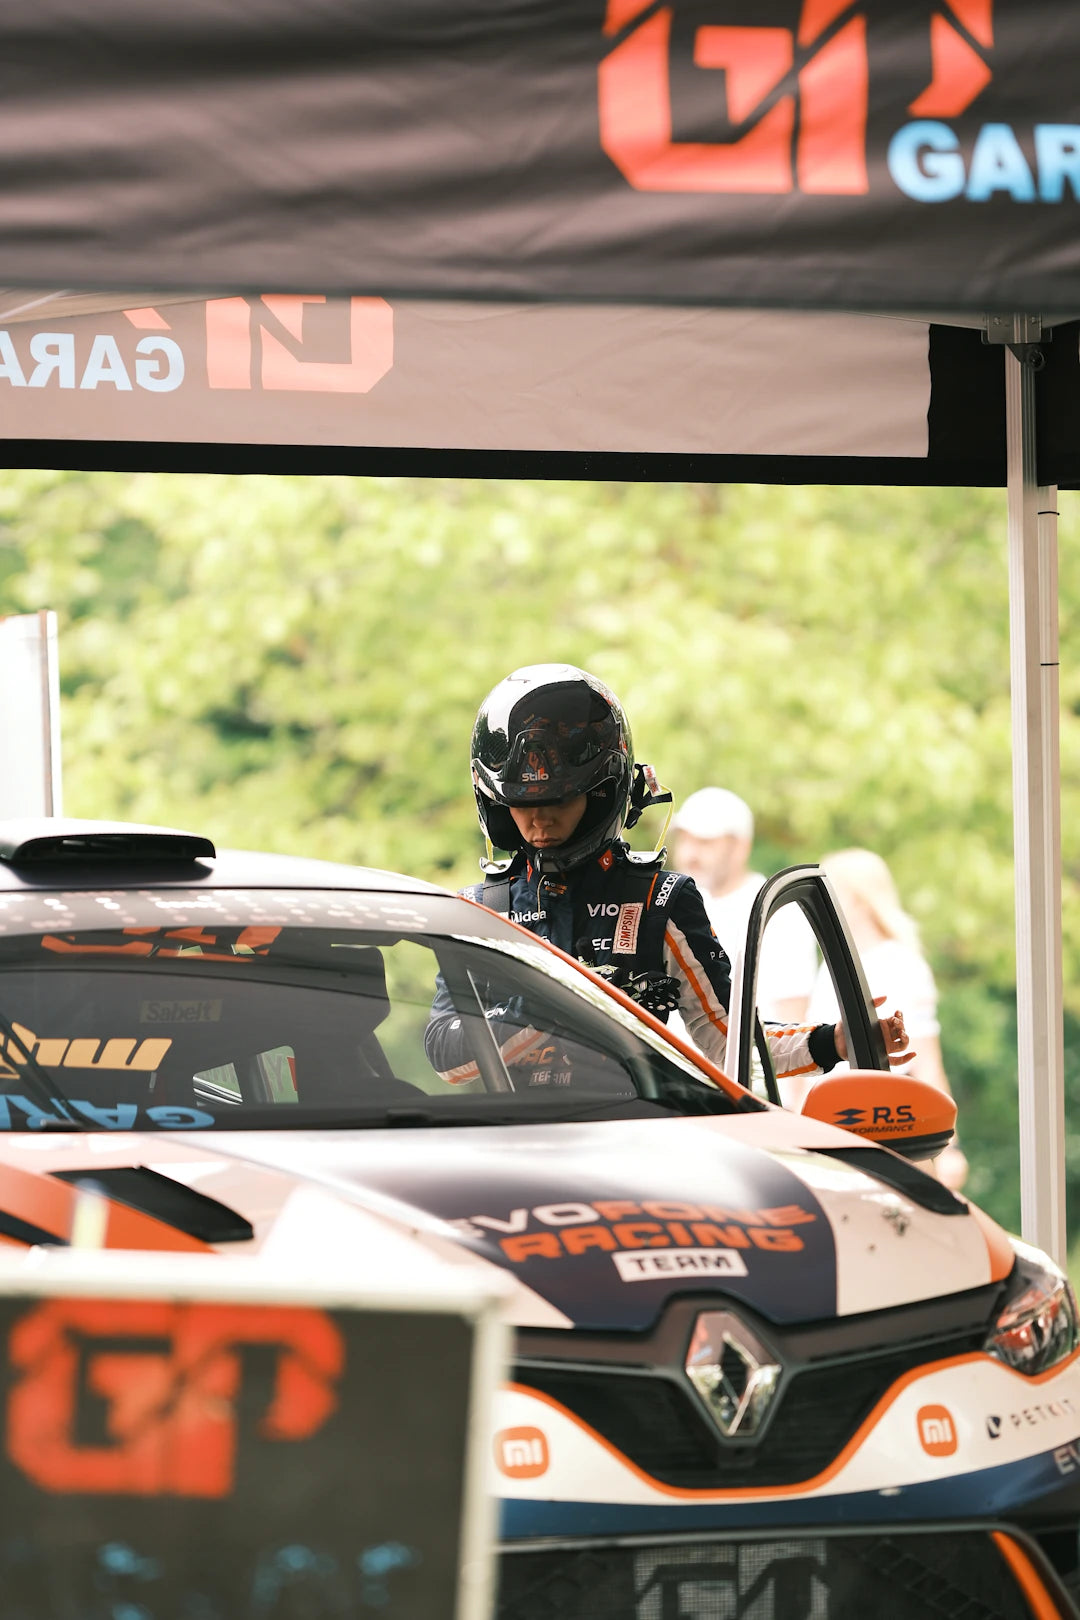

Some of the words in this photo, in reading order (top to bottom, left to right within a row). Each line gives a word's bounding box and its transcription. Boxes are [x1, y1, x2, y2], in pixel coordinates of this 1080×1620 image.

[521, 767, 549, 782] Stilo
[619, 909, 636, 949] SIMPSON
[499, 1222, 805, 1263] RACING
[625, 1254, 733, 1273] TEAM
